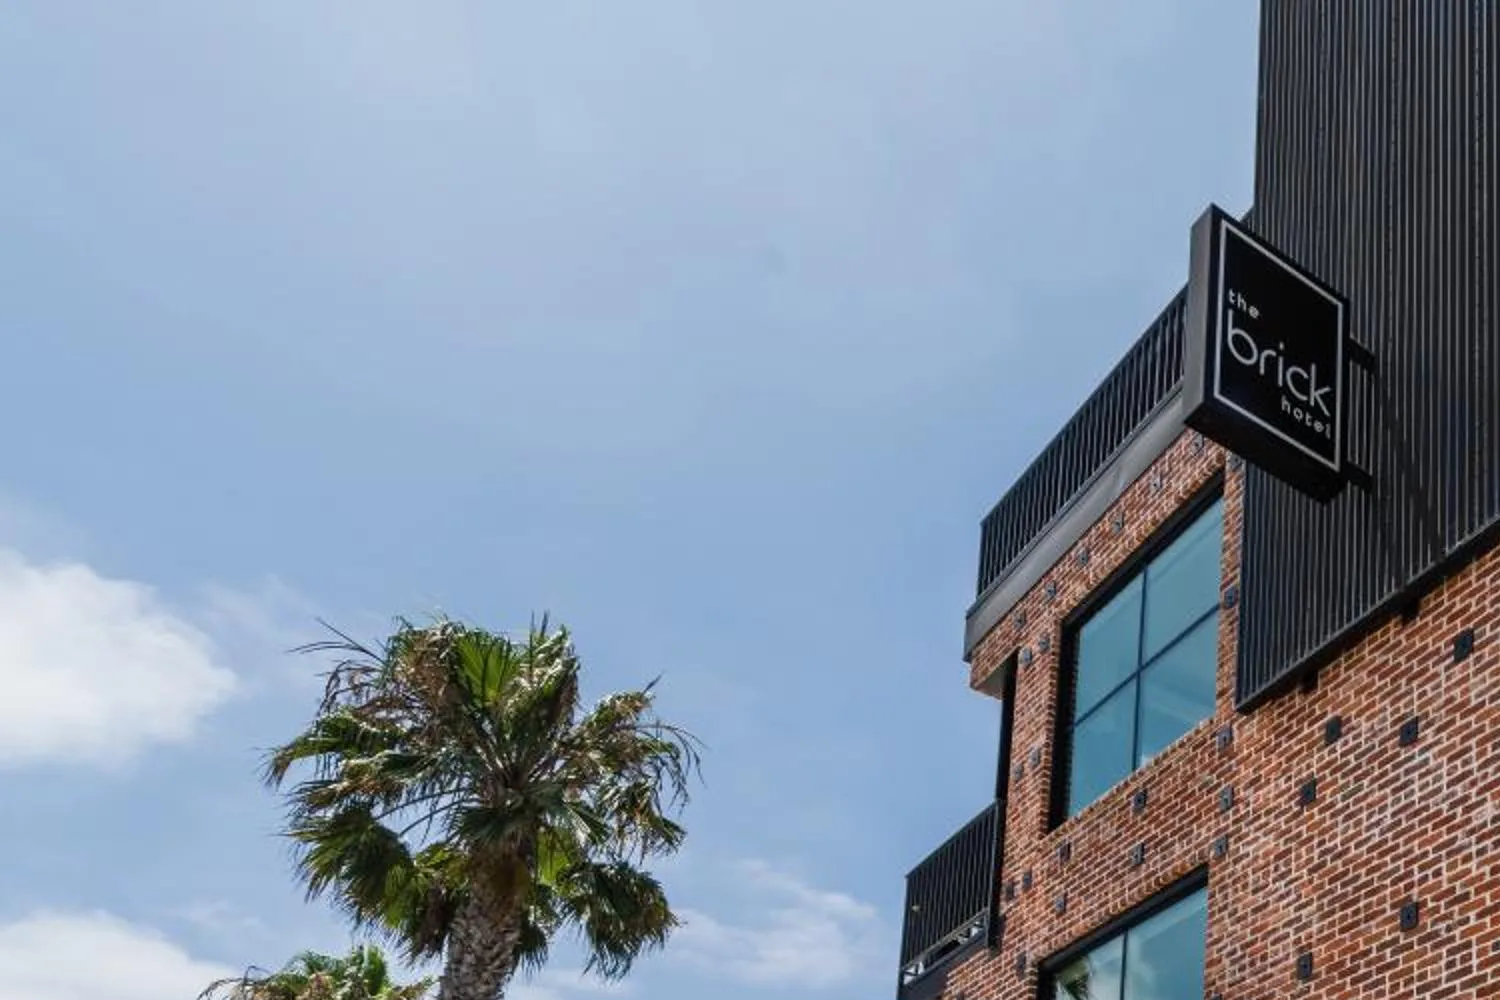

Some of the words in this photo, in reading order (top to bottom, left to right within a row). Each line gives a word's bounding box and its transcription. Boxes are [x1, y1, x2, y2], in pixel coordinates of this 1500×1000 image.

[1229, 287, 1260, 320] the
[1227, 308, 1332, 417] brick
[1281, 395, 1331, 440] hotel
